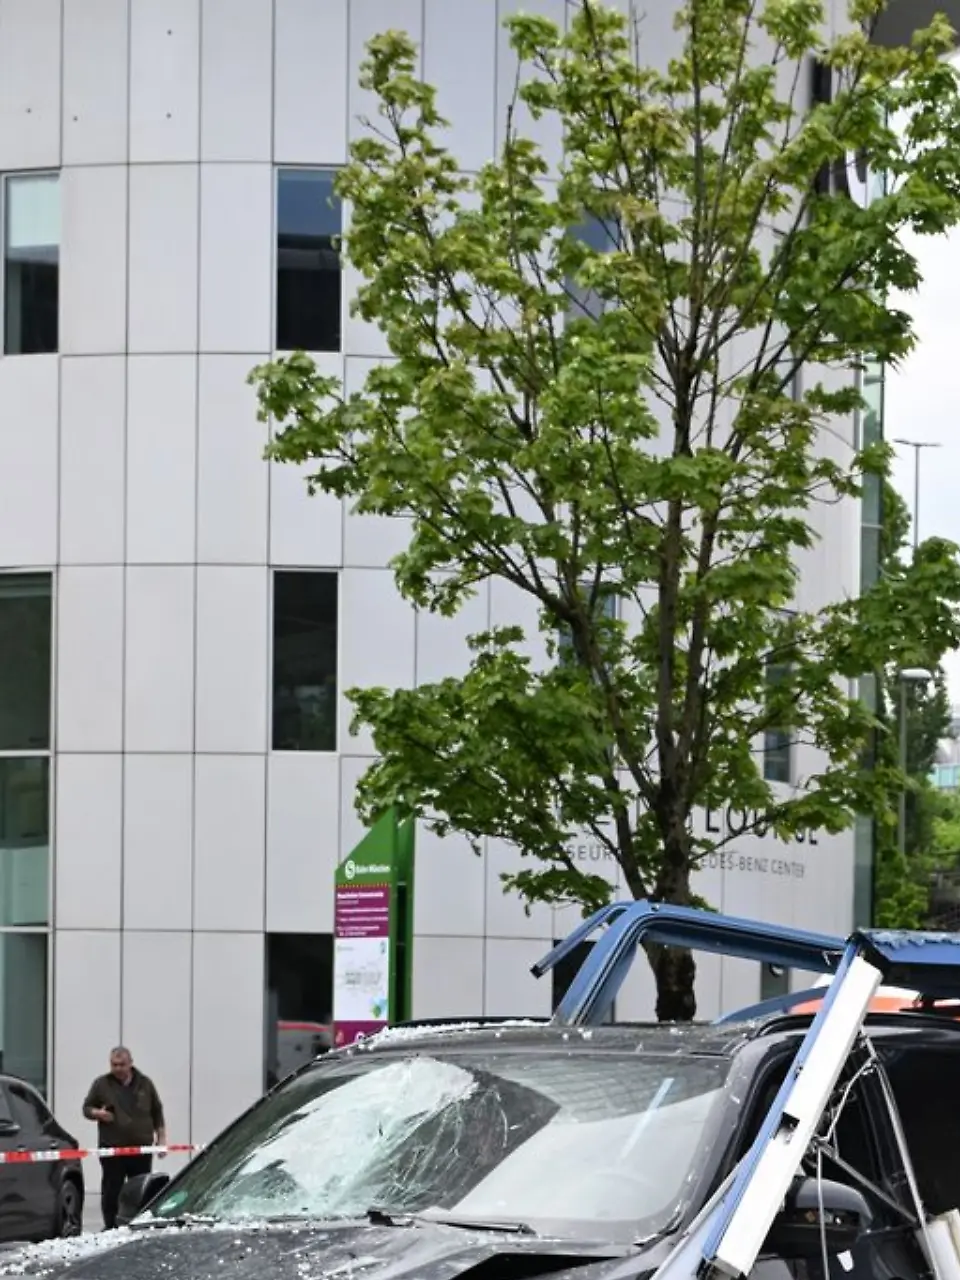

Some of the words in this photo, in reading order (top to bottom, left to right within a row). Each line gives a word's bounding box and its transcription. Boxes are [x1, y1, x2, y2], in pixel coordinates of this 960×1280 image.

[706, 802, 818, 845] LOU
[566, 844, 613, 862] SEUR
[701, 853, 769, 873] EDES-BENZ
